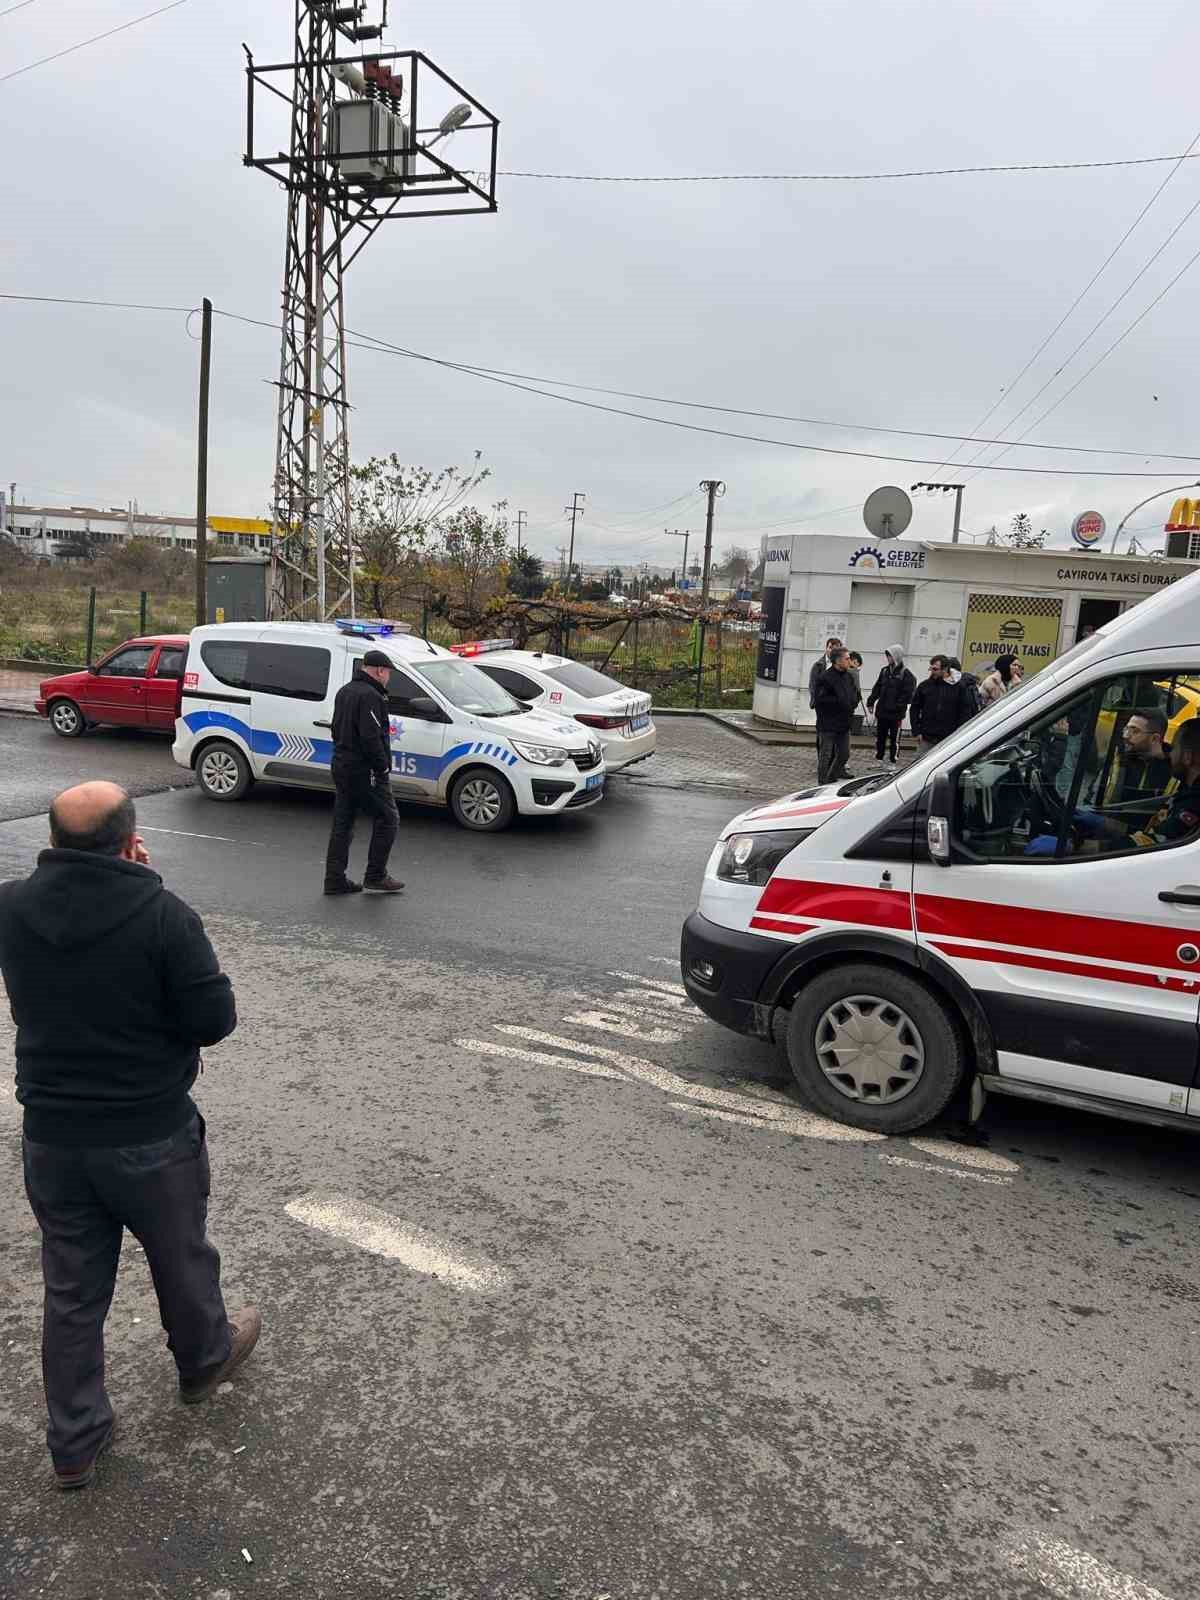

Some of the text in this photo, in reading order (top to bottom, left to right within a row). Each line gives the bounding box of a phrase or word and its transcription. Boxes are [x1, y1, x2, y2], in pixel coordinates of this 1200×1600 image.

[1079, 525, 1101, 535] KING
[888, 550, 925, 562] GEBZE
[1057, 569, 1182, 585] ÇAYIROVA TAKSİ DURAĞ
[969, 642, 1050, 657] ÇAYIROVA TAKSİ
[386, 752, 417, 774] LİS
